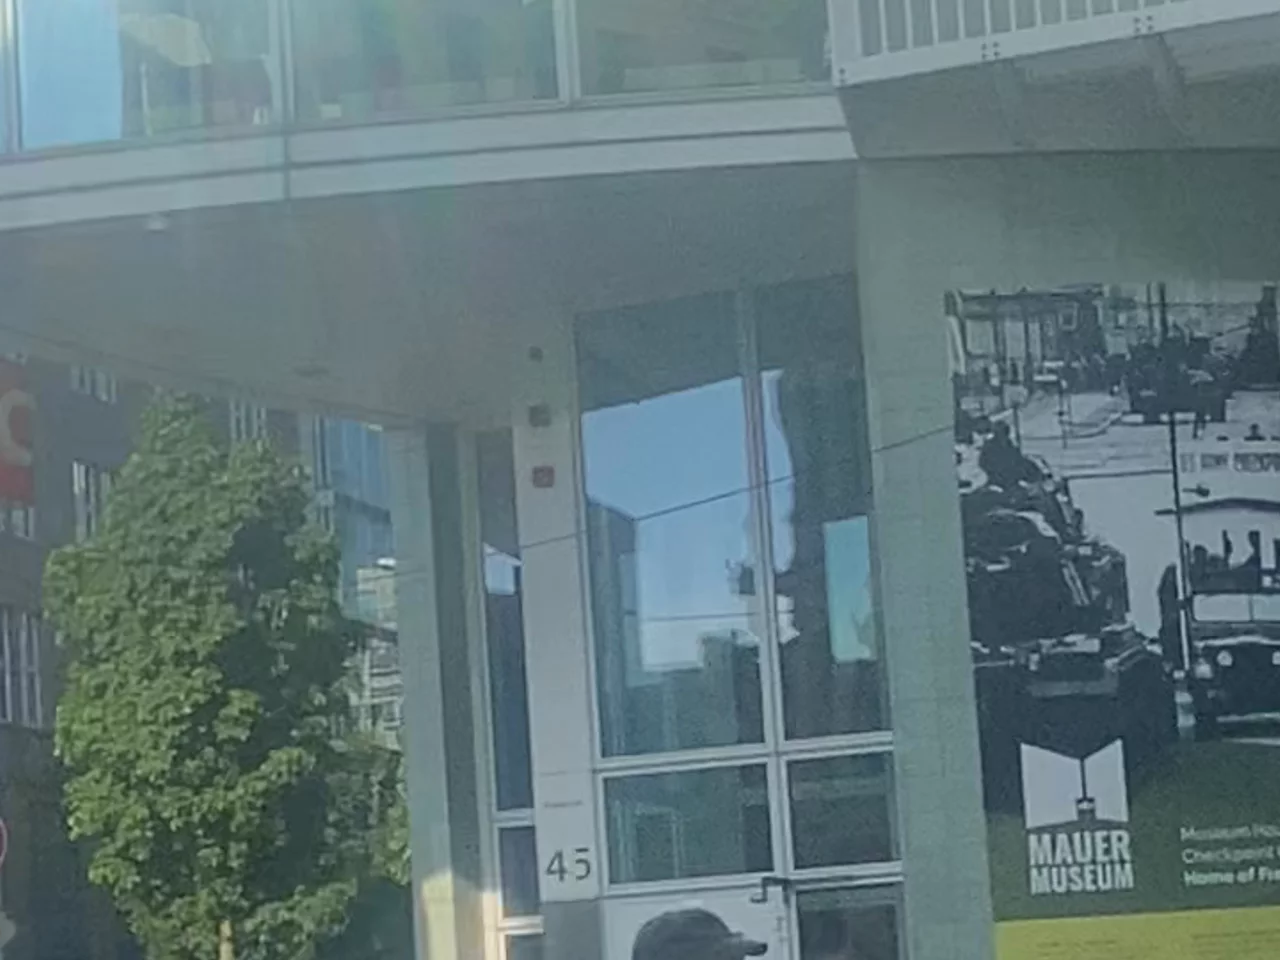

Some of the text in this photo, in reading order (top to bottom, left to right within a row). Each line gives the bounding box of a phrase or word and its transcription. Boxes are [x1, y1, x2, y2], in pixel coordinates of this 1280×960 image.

[1180, 826, 1252, 841] Museum
[1028, 829, 1131, 866] MAUER
[1182, 846, 1275, 864] Checkpoint
[545, 847, 592, 883] 45
[1183, 870, 1234, 887] Home
[1236, 866, 1255, 884] of
[1030, 863, 1134, 896] MUSEUM
